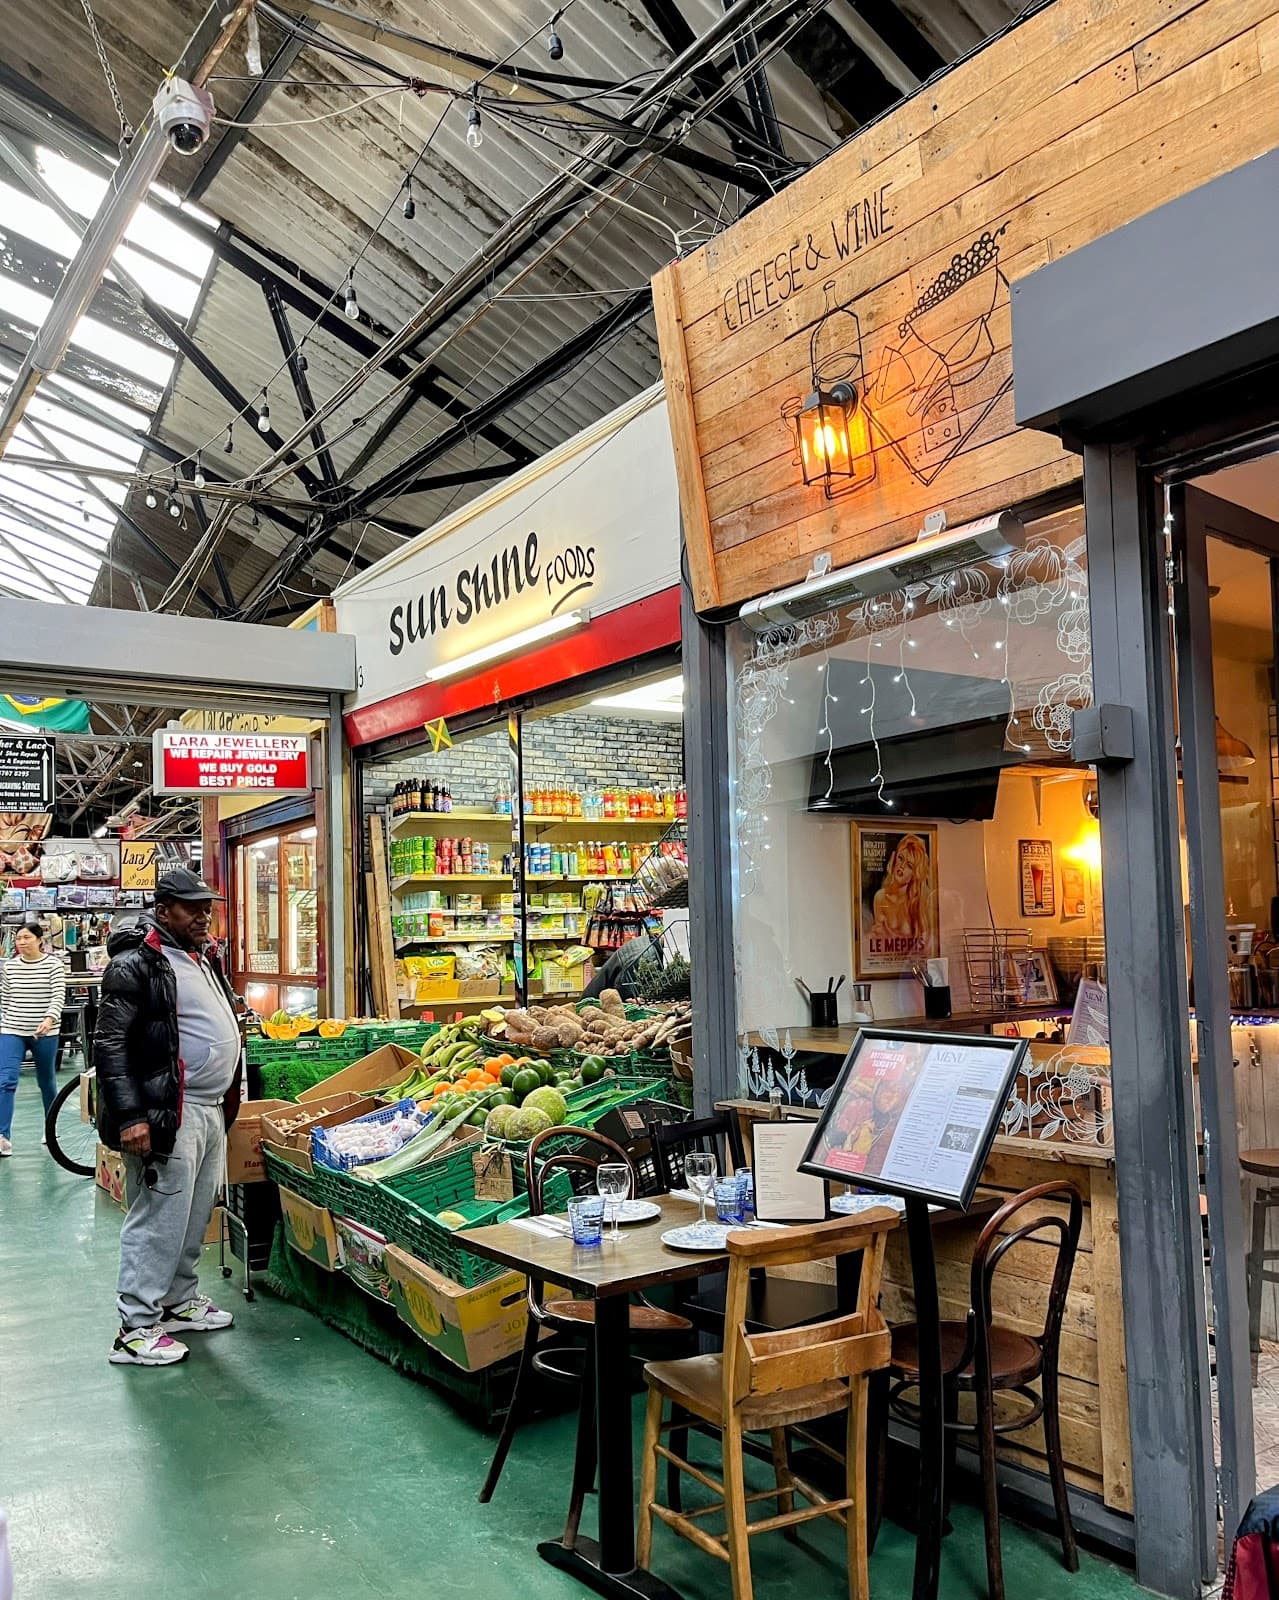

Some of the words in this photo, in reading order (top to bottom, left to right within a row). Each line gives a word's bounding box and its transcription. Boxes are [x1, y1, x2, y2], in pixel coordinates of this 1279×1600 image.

[723, 245, 803, 331] CHEESE
[805, 231, 831, 272] &
[831, 182, 895, 261] WINE
[546, 545, 595, 596] FOODS
[16, 740, 23, 749] &
[26, 740, 47, 750] Lace
[169, 736, 209, 747] LARA
[214, 737, 299, 749] JEWELLERY
[170, 749, 189, 759] WE
[191, 750, 233, 759] REPAIR
[236, 751, 300, 761] JEWELLERY
[198, 763, 217, 773] WE
[219, 764, 244, 774] BUY
[246, 764, 278, 774] GOLD
[199, 776, 234, 787] BEST
[236, 777, 276, 788] PRICE
[122, 848, 145, 865] Lara
[1023, 846, 1050, 855] BEER
[158, 862, 188, 871] WATCH
[870, 938, 882, 953] LE
[935, 1050, 968, 1064] MENU
